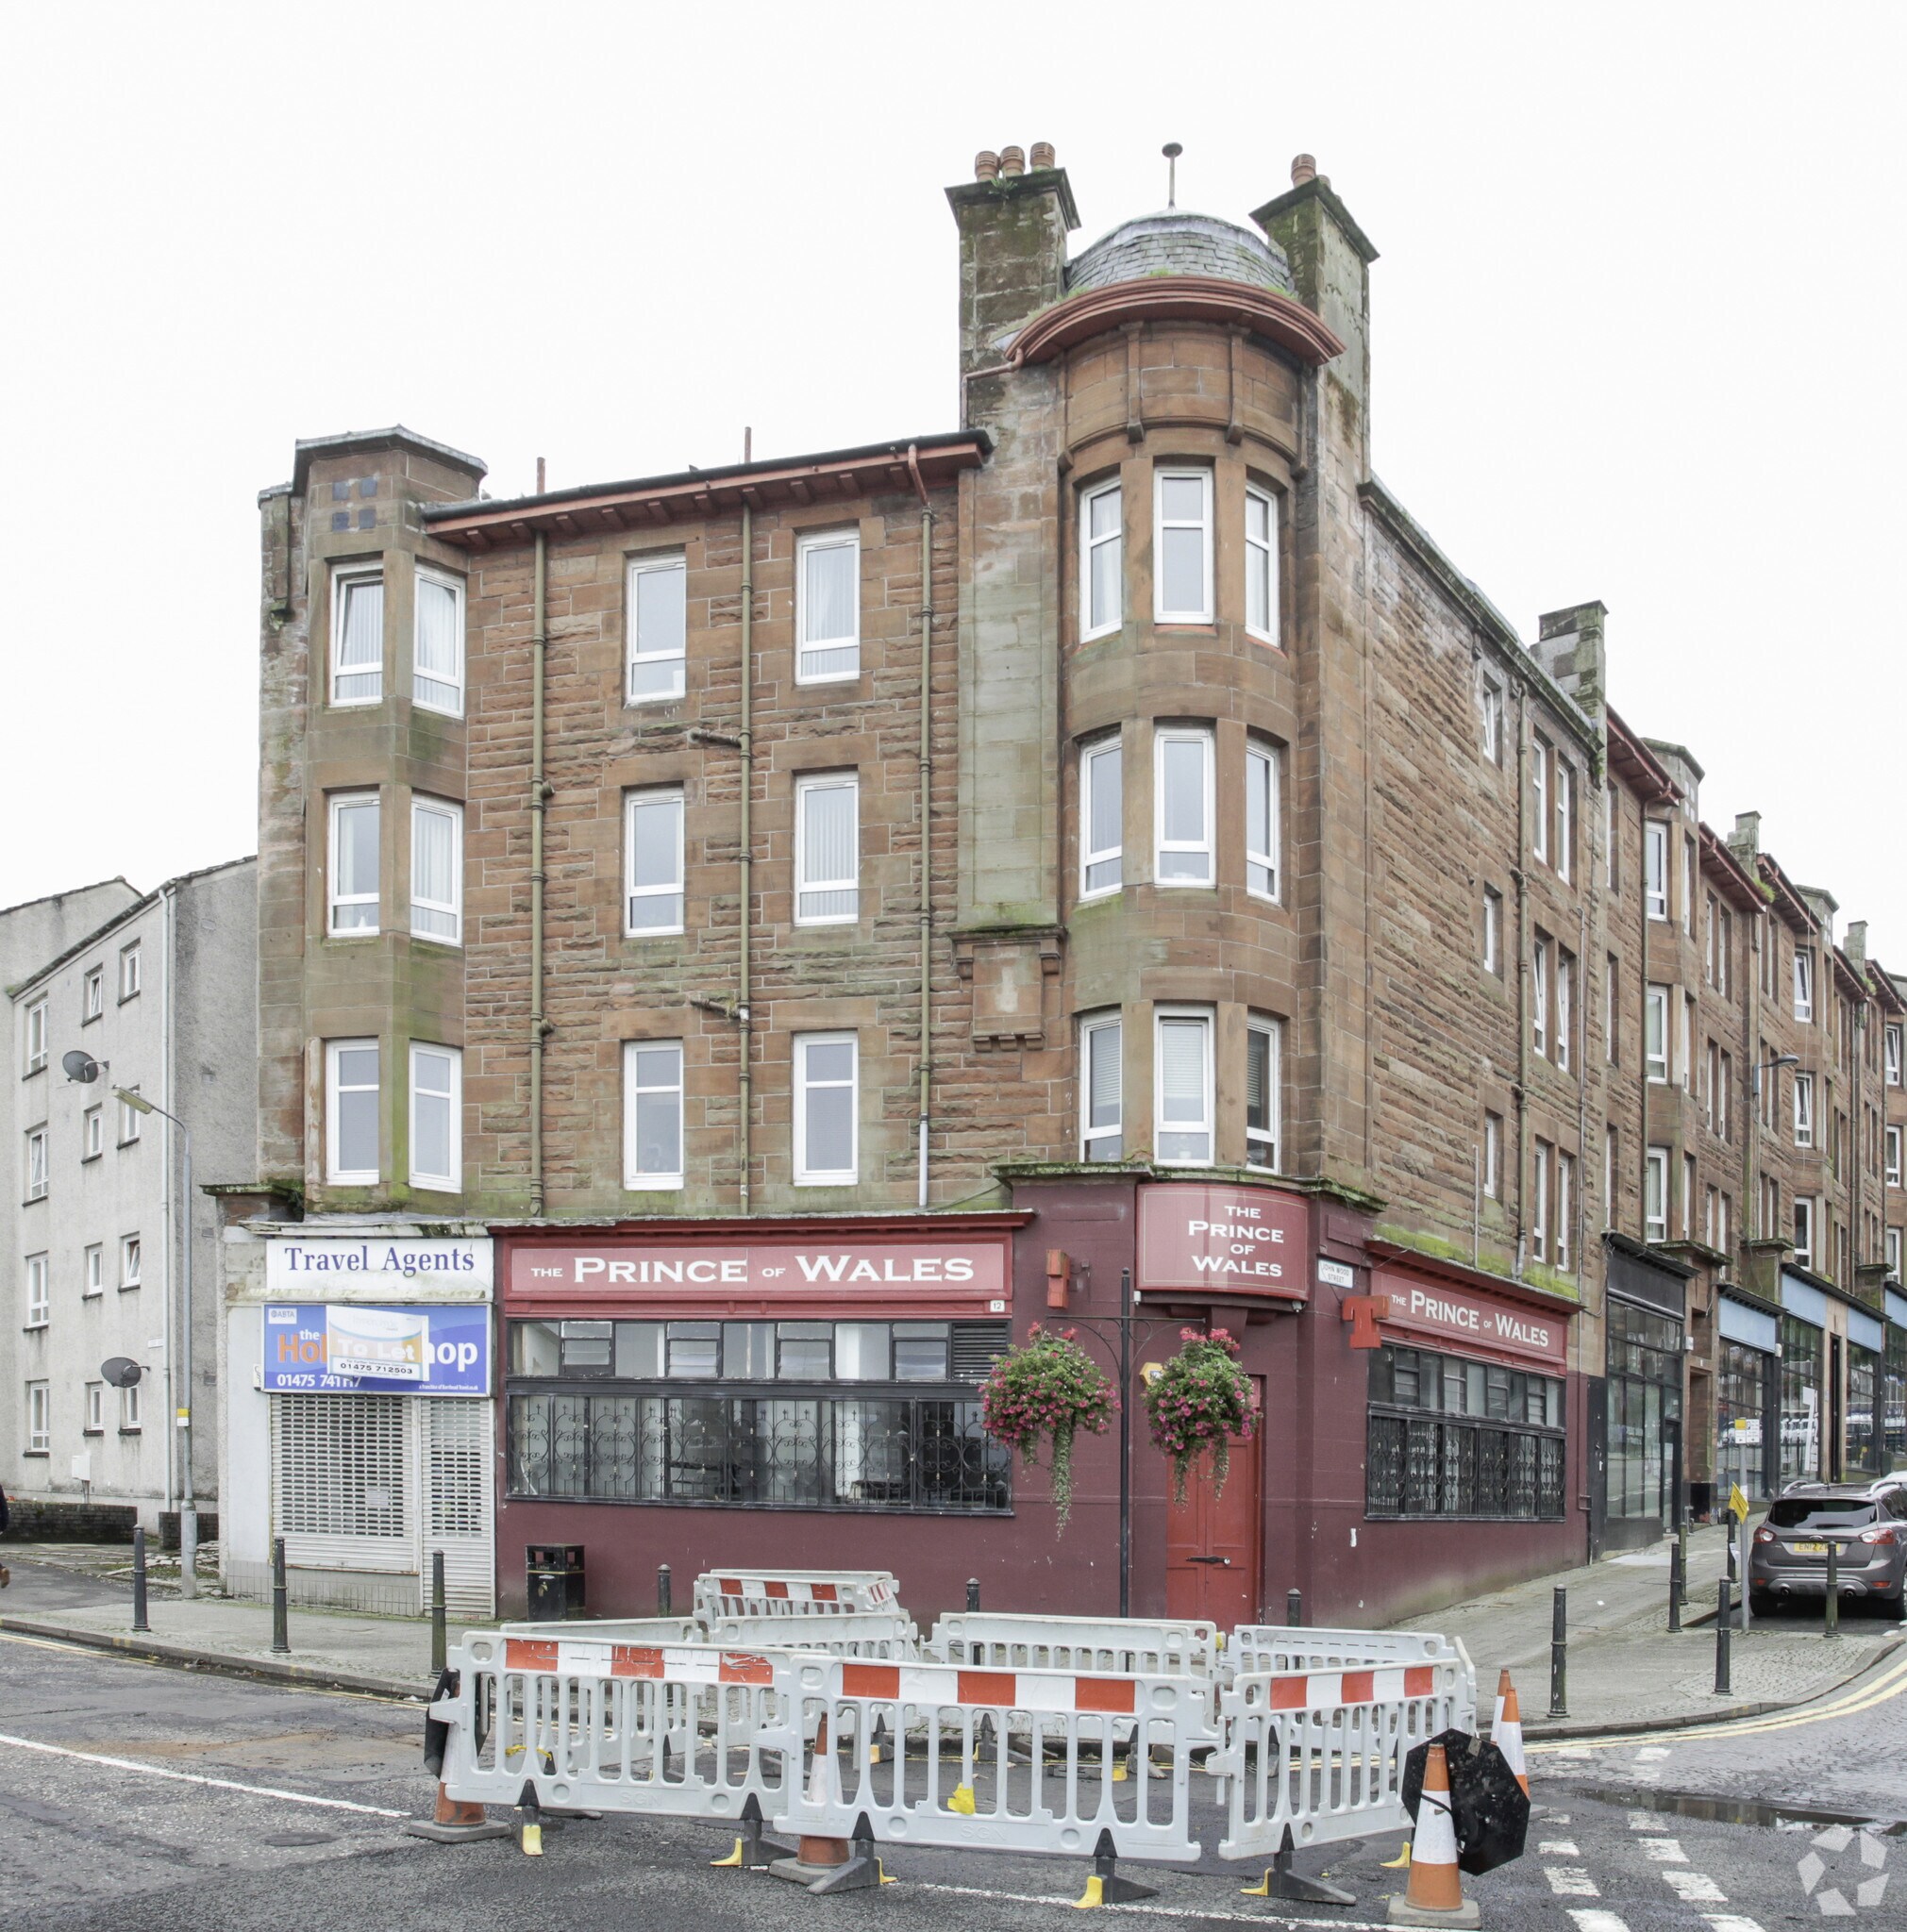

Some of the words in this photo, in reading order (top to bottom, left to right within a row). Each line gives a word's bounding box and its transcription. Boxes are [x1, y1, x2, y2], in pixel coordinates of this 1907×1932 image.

[1224, 1206, 1262, 1219] THE
[1188, 1220, 1284, 1243] PRINCE
[1230, 1244, 1256, 1255] OF
[285, 1245, 369, 1271] Travel
[383, 1246, 475, 1277] Agents
[1191, 1255, 1282, 1277] WALES
[530, 1267, 563, 1277] THE
[573, 1257, 748, 1284] PRINCE
[761, 1267, 786, 1277] OF
[795, 1255, 975, 1282] WALES
[1328, 1274, 1345, 1284] STREET
[993, 1302, 1002, 1310] 12
[1391, 1294, 1407, 1306] THE
[1411, 1290, 1480, 1331] PRINCE
[1483, 1320, 1493, 1329] OF
[1495, 1312, 1548, 1348] WALES
[299, 1328, 321, 1341] the
[337, 1340, 369, 1357] To
[377, 1342, 415, 1361] Let
[340, 1362, 372, 1372] 01475
[376, 1365, 413, 1374] 712503
[276, 1374, 317, 1388] 01475
